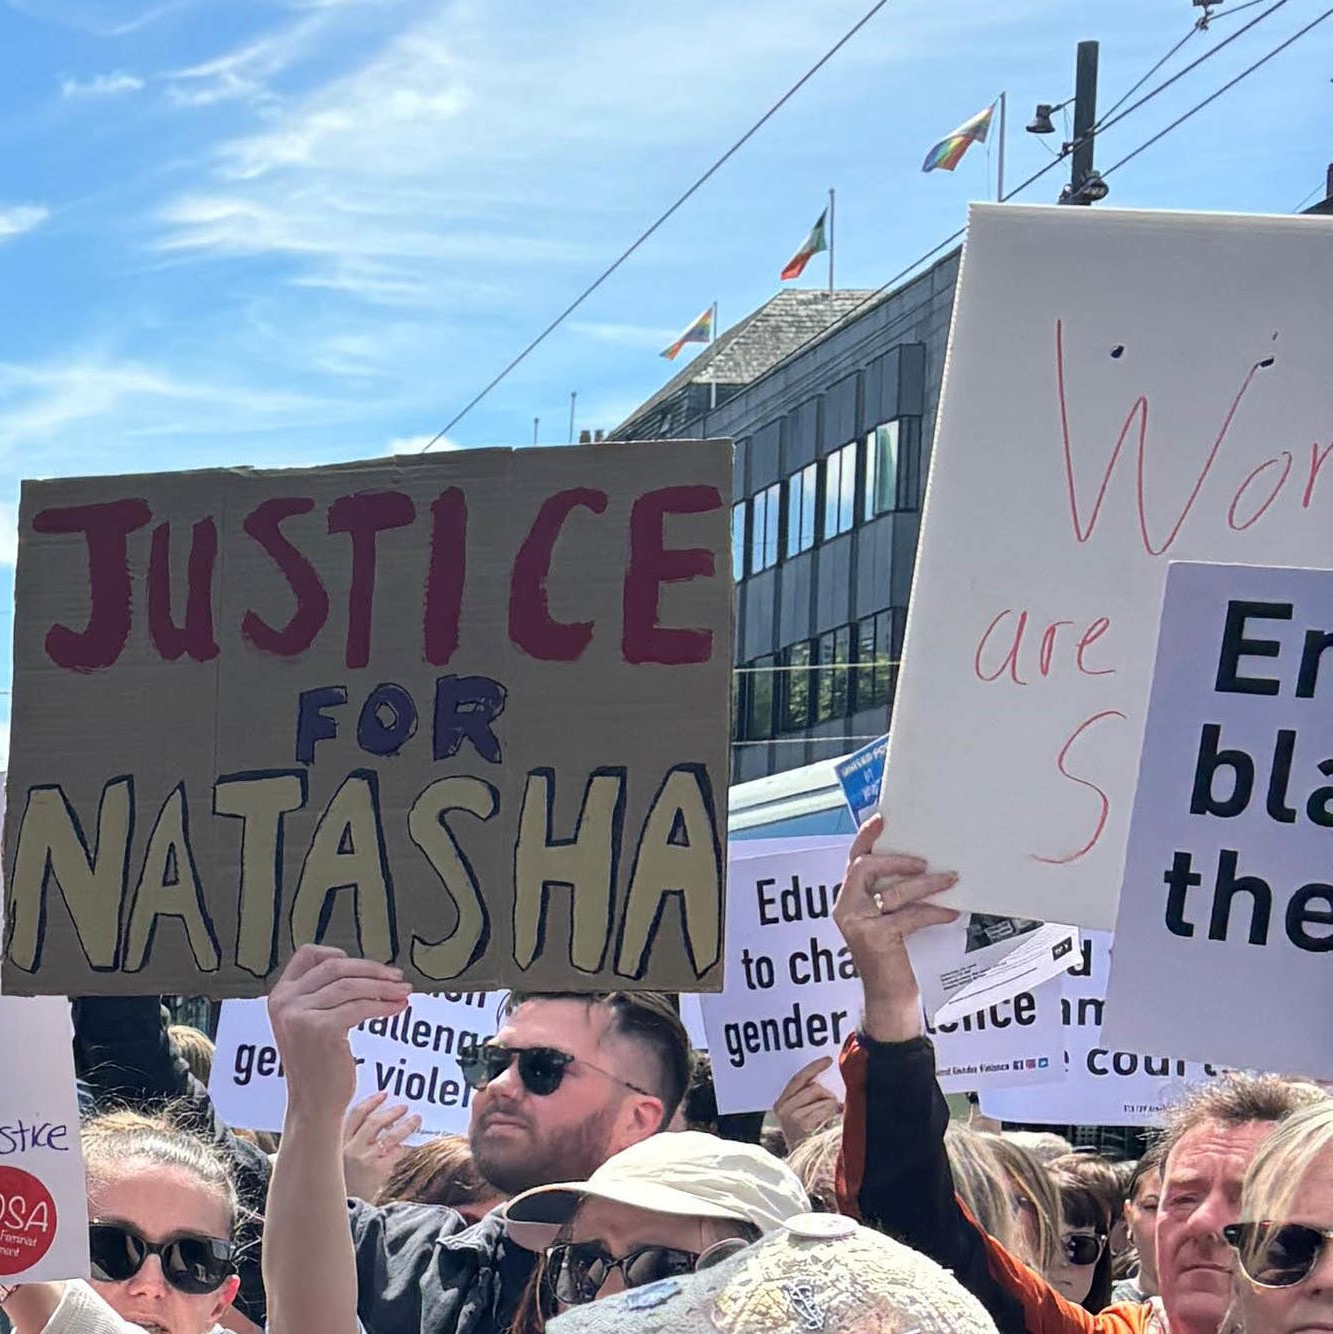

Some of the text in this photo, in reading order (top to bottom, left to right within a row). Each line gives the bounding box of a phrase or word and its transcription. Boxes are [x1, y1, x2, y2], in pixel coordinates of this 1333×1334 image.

[33, 485, 724, 674] JUSTICE
[975, 609, 1115, 685] are
[296, 673, 509, 765] FOR
[5, 762, 724, 982] NATASHA
[742, 949, 775, 991] to
[724, 1002, 847, 1068] gender
